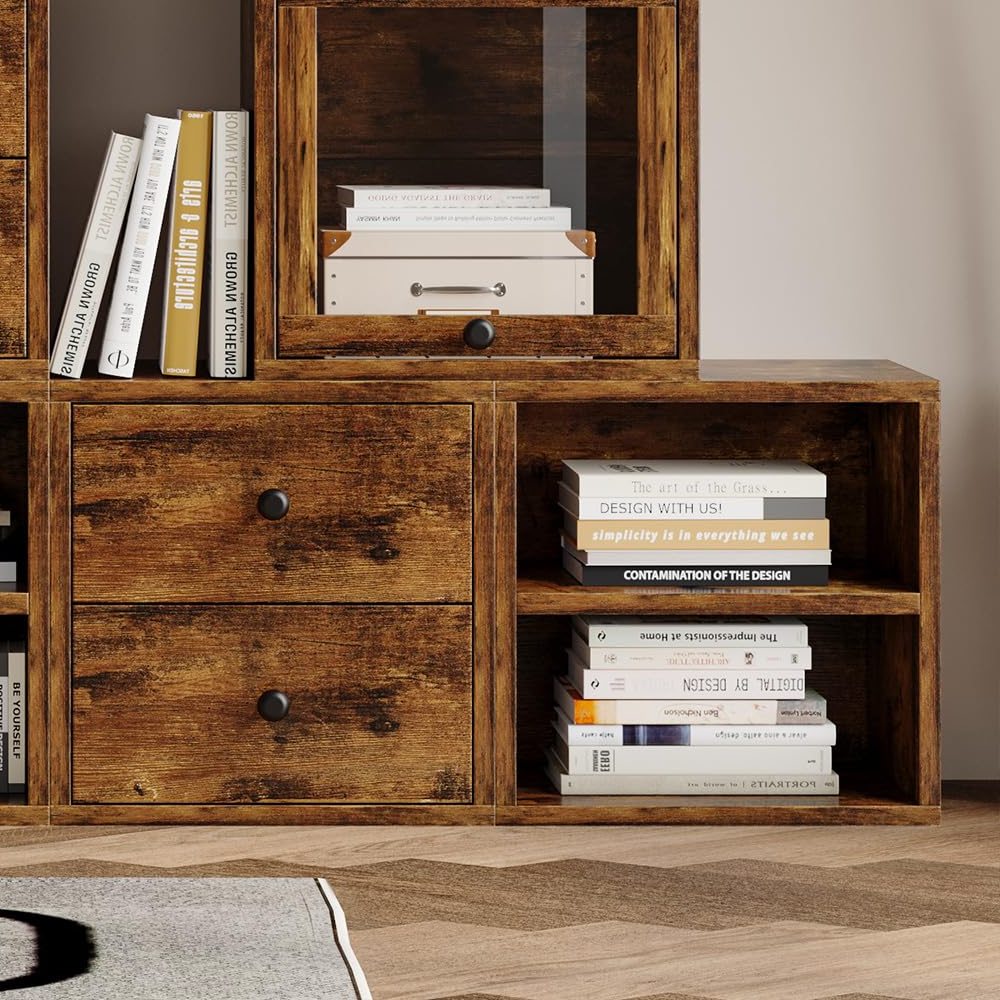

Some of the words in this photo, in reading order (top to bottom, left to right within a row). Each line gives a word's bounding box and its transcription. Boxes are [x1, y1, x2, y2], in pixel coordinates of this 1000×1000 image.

[631, 481, 651, 494] The
[659, 482, 679, 494] art
[686, 481, 701, 494] of
[707, 481, 728, 494] the
[733, 481, 788, 494] Grass...
[600, 502, 653, 515] DESIGN
[658, 502, 694, 515] WITH
[699, 502, 723, 515] US!
[592, 528, 659, 543] simplicity
[662, 529, 674, 541] is
[678, 529, 692, 541] in
[696, 529, 767, 543] everything
[770, 531, 789, 541] we
[793, 531, 815, 541] see
[623, 570, 712, 581] CONTAMINATION
[713, 570, 729, 581] OF
[729, 570, 751, 581] THE
[751, 570, 791, 581] DESIGN
[639, 633, 668, 642] Home
[672, 633, 681, 642] at
[684, 632, 756, 643] Impressionists
[760, 633, 778, 642] The
[13, 682, 21, 697] BE
[683, 678, 727, 692] DESIGN
[735, 678, 749, 692] BY
[757, 678, 804, 692] DIGITAL
[664, 708, 702, 718] Nicholson
[703, 709, 719, 718] Ben
[13, 699, 21, 760] YOURSELF
